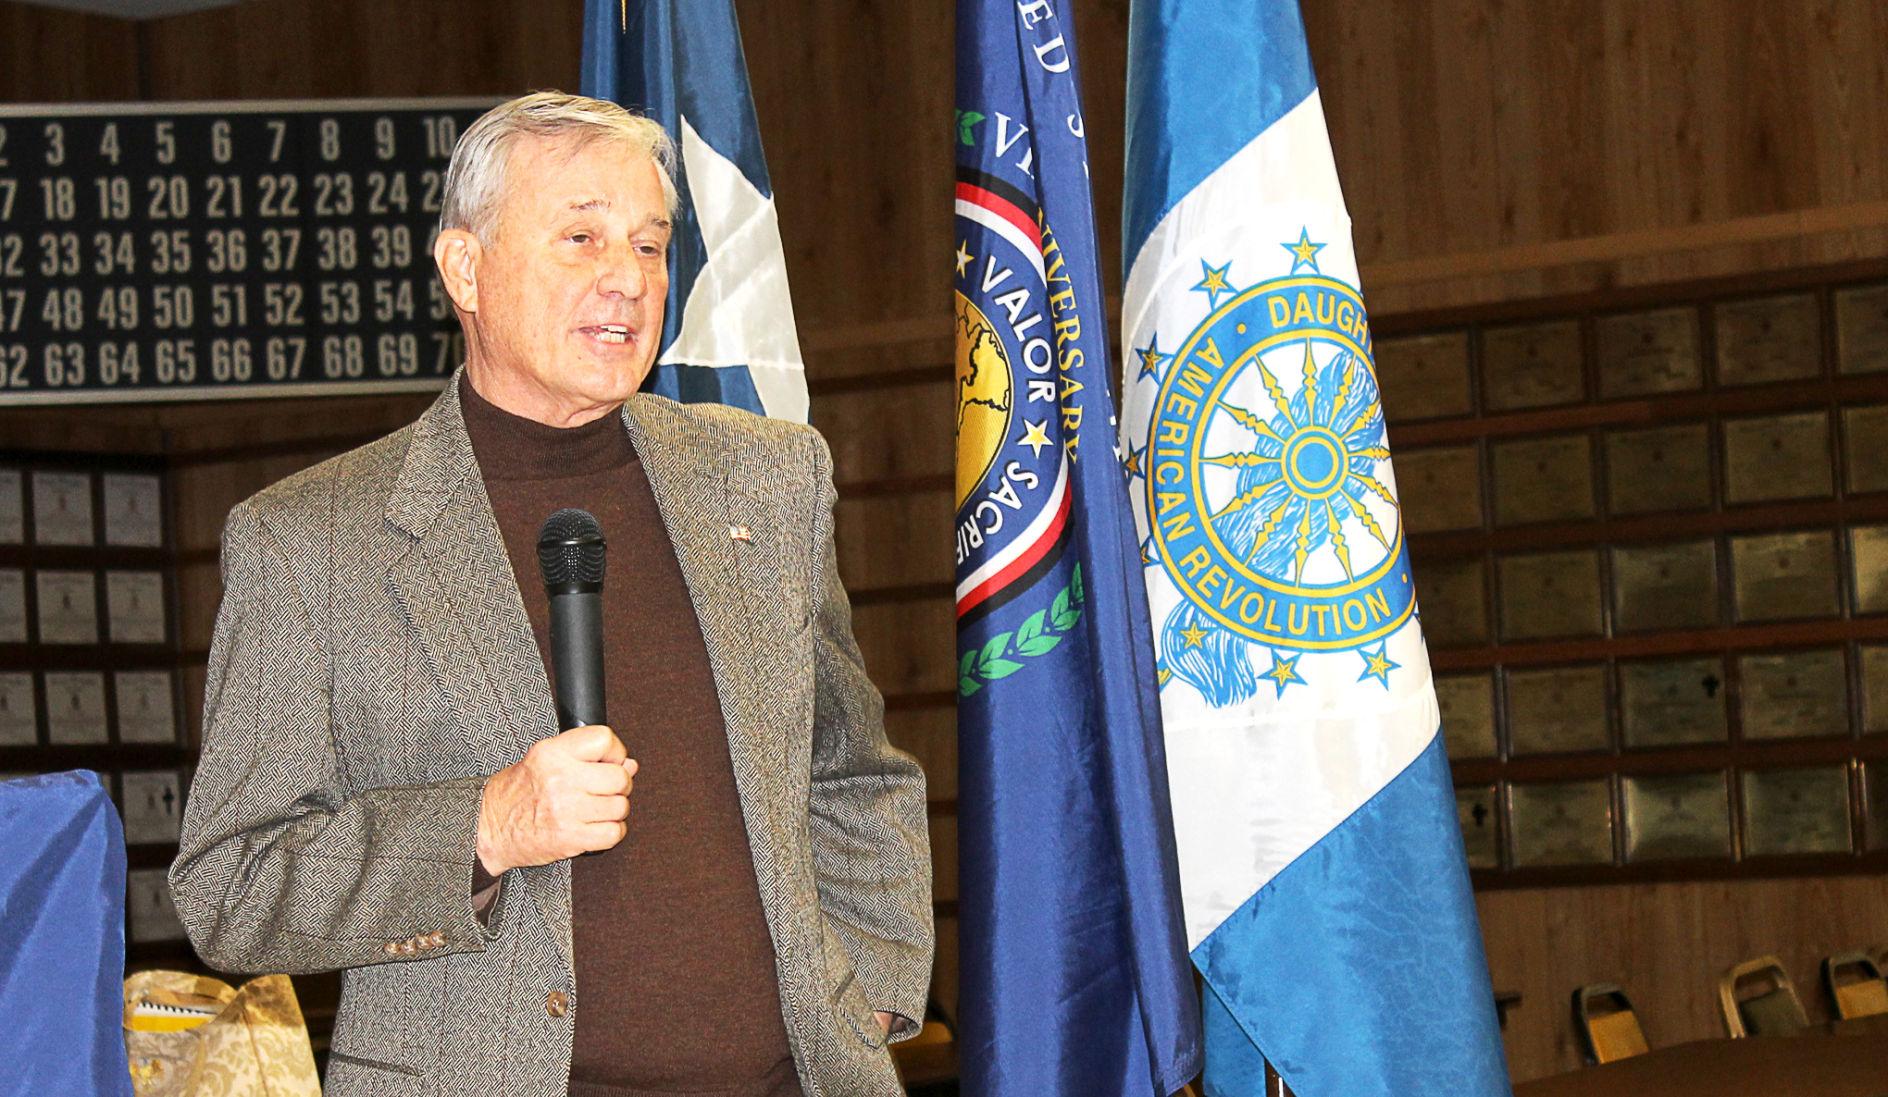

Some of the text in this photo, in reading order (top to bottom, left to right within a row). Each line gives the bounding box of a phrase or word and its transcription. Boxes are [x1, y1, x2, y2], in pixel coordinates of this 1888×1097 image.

[45, 123, 64, 165] 3
[100, 124, 119, 164] 4
[156, 122, 175, 164] 5
[212, 121, 231, 163] 6
[267, 121, 285, 161] 7
[321, 119, 339, 160] 8
[376, 119, 395, 159] 9
[423, 117, 455, 158] 10
[40, 177, 75, 220] 18
[95, 176, 130, 219] 19
[148, 176, 189, 219] 20
[207, 176, 242, 218] 21
[259, 175, 299, 217] 22
[314, 174, 354, 216] 23
[368, 172, 408, 213] 24
[421, 170, 446, 211] 2
[0, 234, 24, 277] 2
[39, 233, 80, 276] 33
[94, 233, 135, 274] 34
[151, 231, 191, 274] 35
[207, 229, 247, 272] 36
[262, 229, 301, 271] 37
[318, 227, 357, 270] 38
[372, 225, 411, 268] 39
[0, 278, 457, 332] 7 48 49 50 51 52 53 54 5
[980, 254, 1058, 404] VALOR
[1266, 291, 1372, 355] DAUGH
[44, 343, 86, 387] 63
[99, 342, 140, 384] 64
[155, 340, 196, 384] 65
[211, 338, 252, 381] 66
[267, 338, 306, 381] 67
[323, 335, 363, 378] 68
[378, 333, 418, 376] 69
[1154, 336, 1392, 637] AMERICAN REVOLUTION
